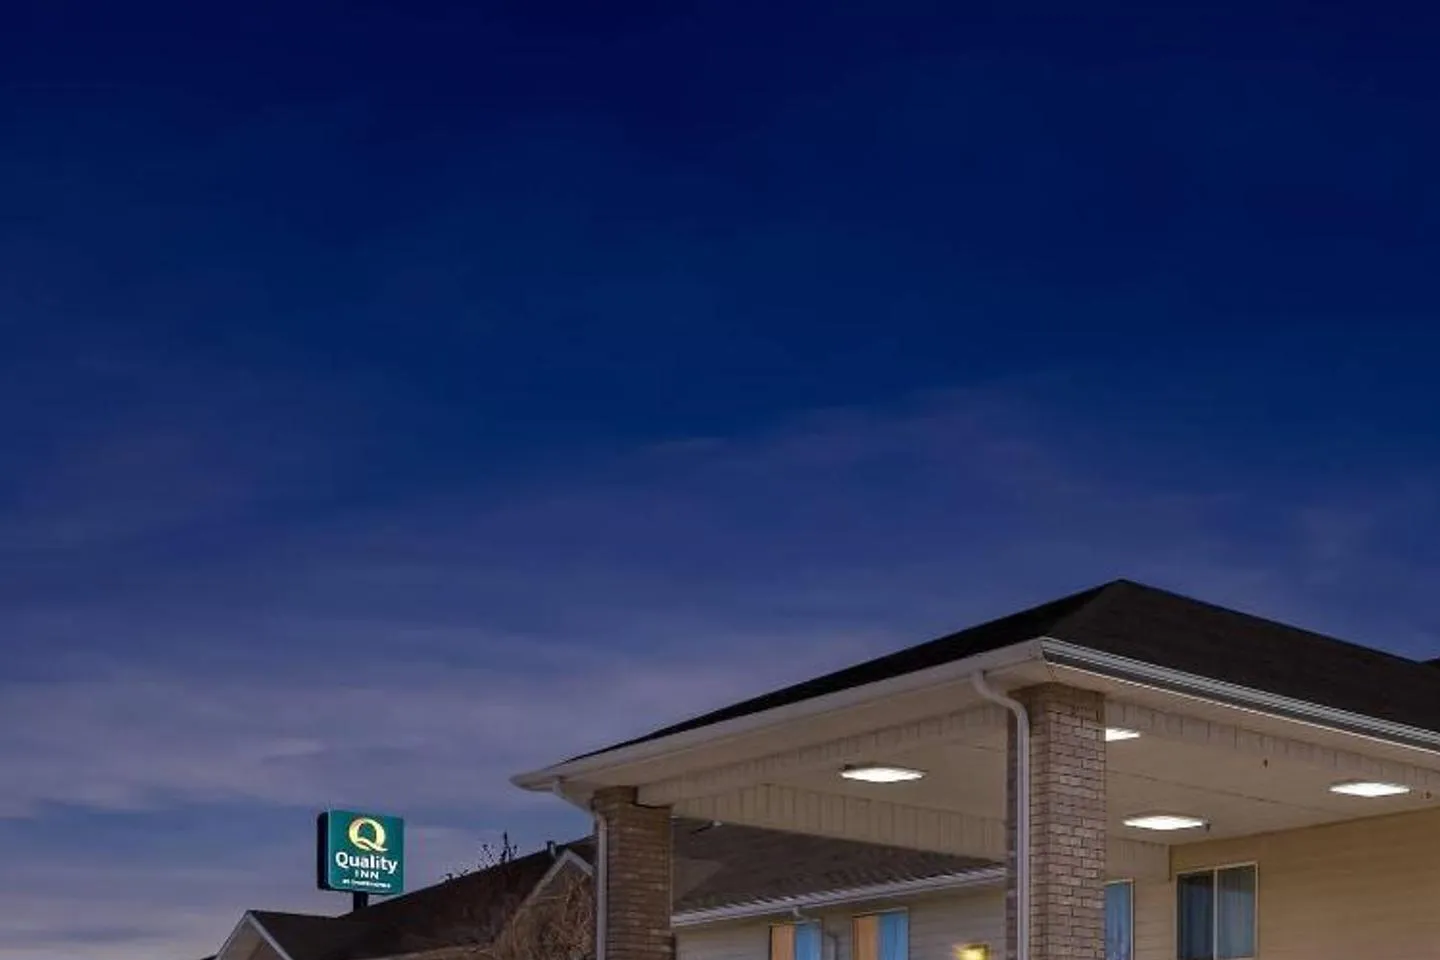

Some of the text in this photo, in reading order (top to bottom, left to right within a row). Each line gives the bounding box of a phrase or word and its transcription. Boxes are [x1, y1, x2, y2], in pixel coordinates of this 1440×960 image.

[348, 817, 388, 852] Q
[335, 851, 398, 874] Quality
[354, 869, 380, 880] INN
